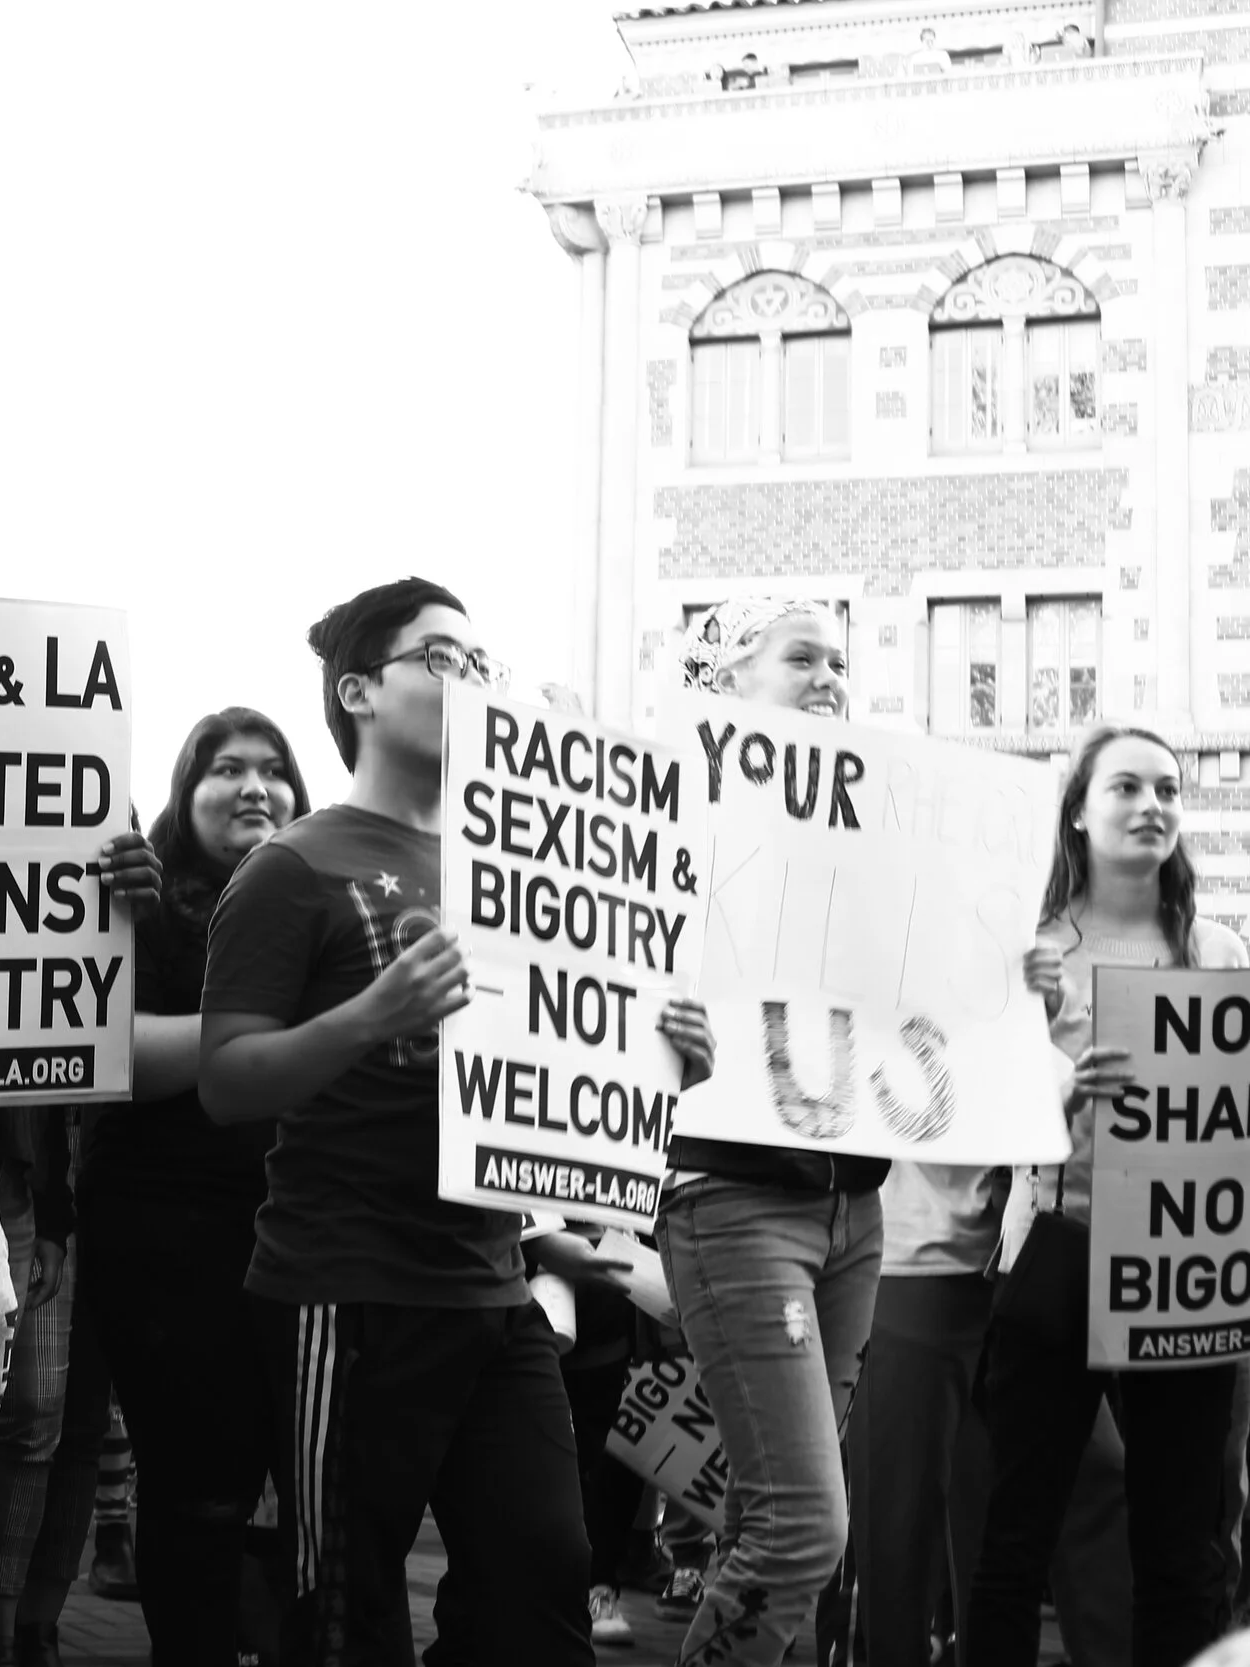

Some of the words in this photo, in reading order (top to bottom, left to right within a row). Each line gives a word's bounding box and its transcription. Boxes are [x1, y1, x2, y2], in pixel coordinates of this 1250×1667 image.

[46, 636, 123, 711] LA
[485, 704, 680, 823] RACISM
[696, 719, 865, 831] YOUR
[462, 781, 658, 893] SEXISM
[672, 847, 698, 896] &
[471, 859, 686, 975] BIGOTRY
[529, 963, 637, 1053] NOT
[1154, 995, 1250, 1055] NO
[760, 1000, 956, 1143] US
[1109, 1085, 1250, 1143] SHA
[1149, 1178, 1244, 1238] NO
[1109, 1250, 1250, 1313] BIGO
